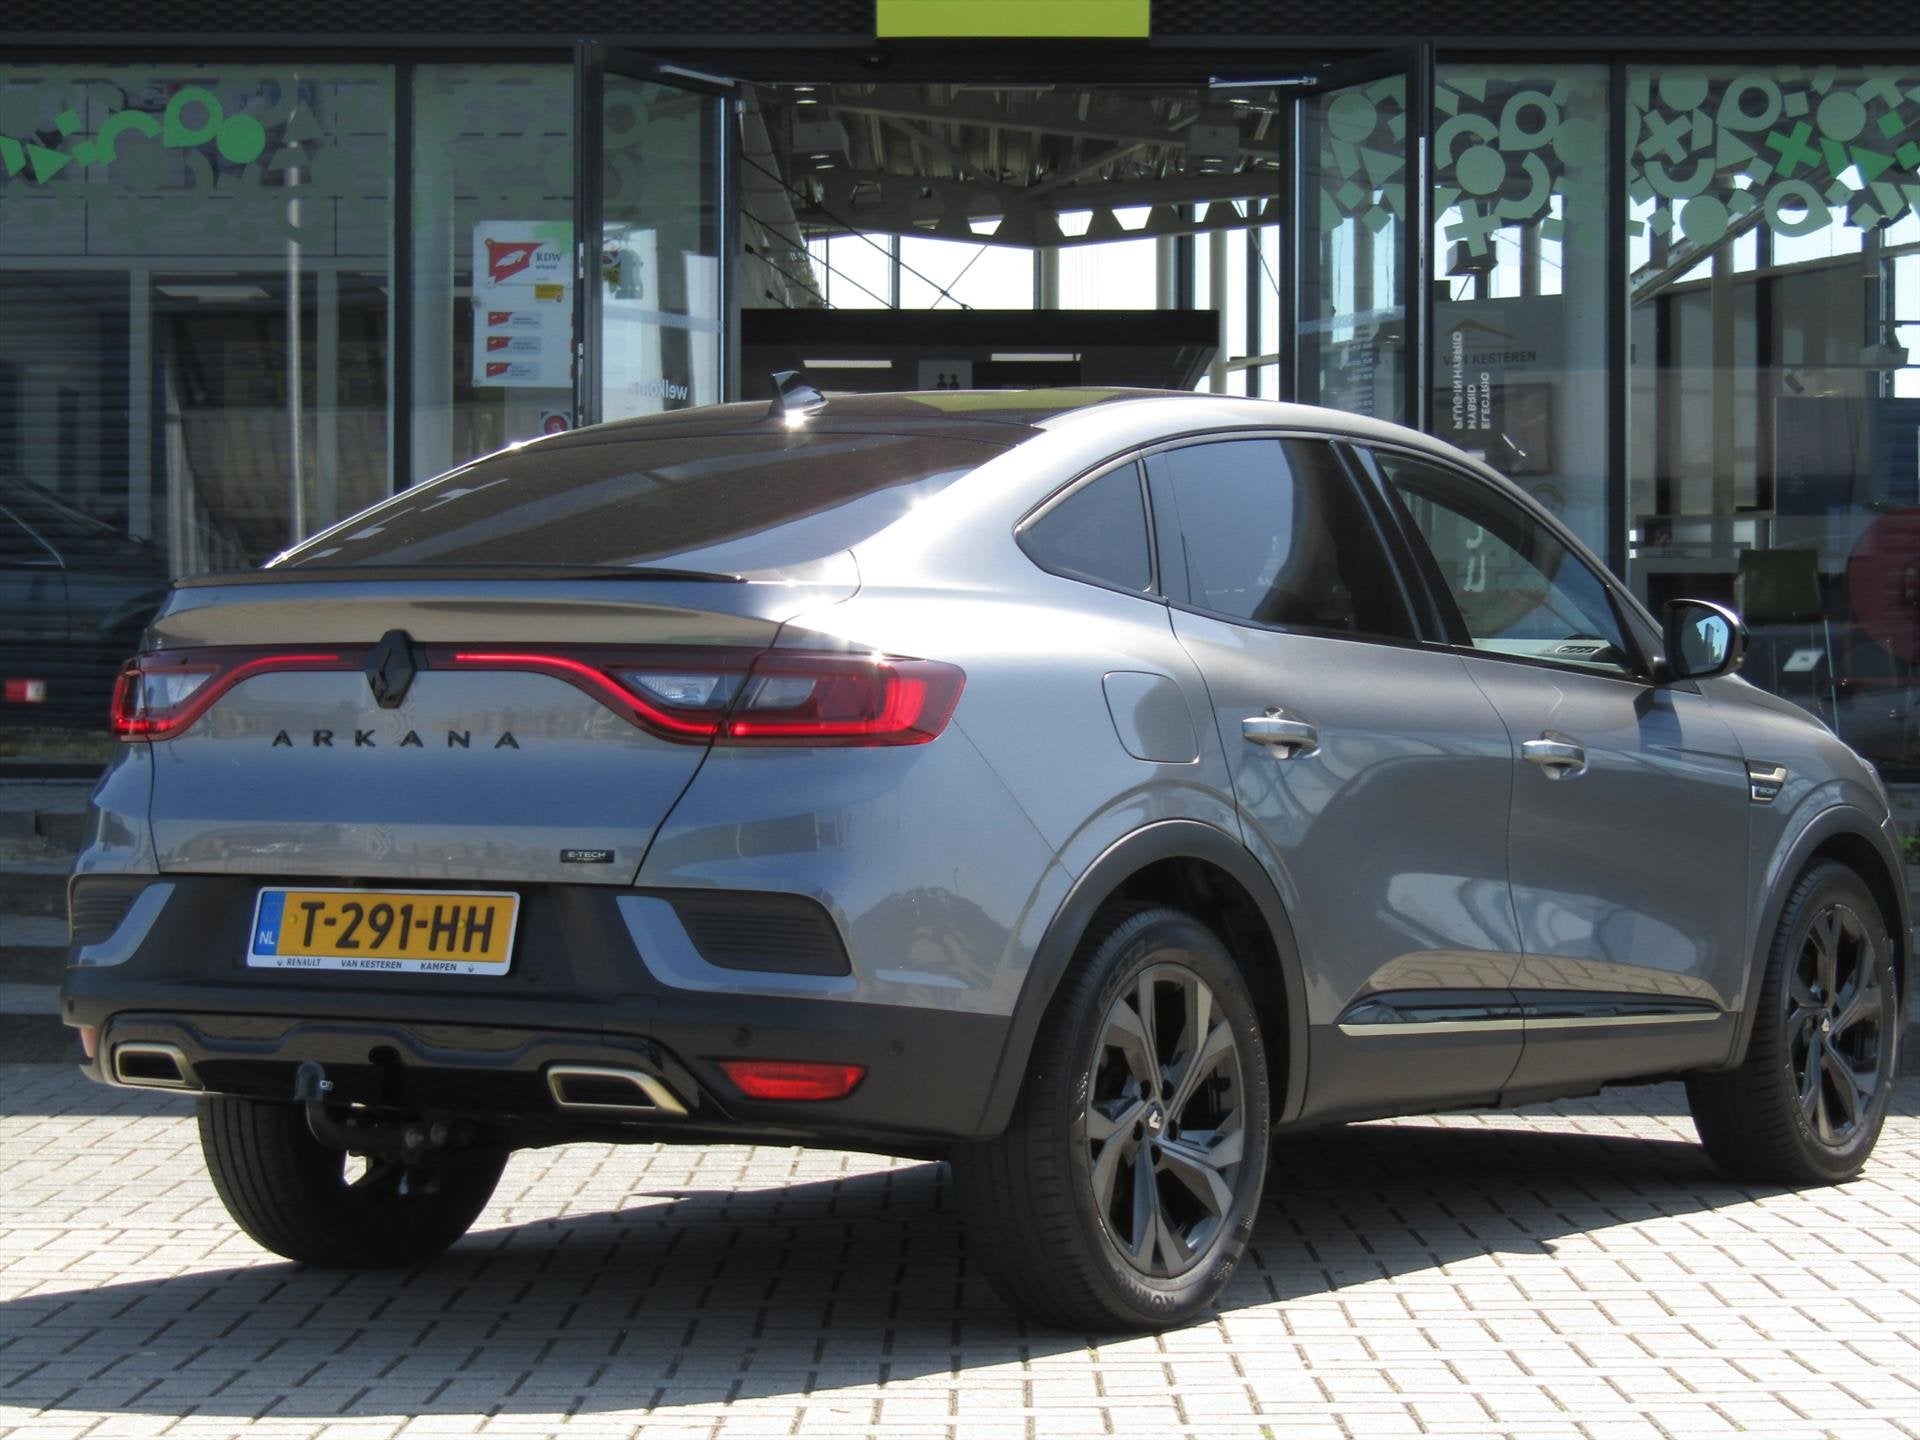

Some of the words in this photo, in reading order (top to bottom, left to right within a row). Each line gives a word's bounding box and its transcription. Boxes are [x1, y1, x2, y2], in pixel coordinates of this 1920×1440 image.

[536, 252, 562, 262] RDW
[1442, 353, 1468, 366] VN
[1472, 351, 1537, 365] KESTEREN
[271, 729, 520, 749] ARKANA
[301, 902, 496, 953] T-291-HH
[259, 931, 275, 945] NL
[286, 958, 321, 967] RENAULT
[341, 959, 358, 968] VAN
[359, 960, 402, 969] KESTEREN
[420, 962, 457, 971] KAMPEN
